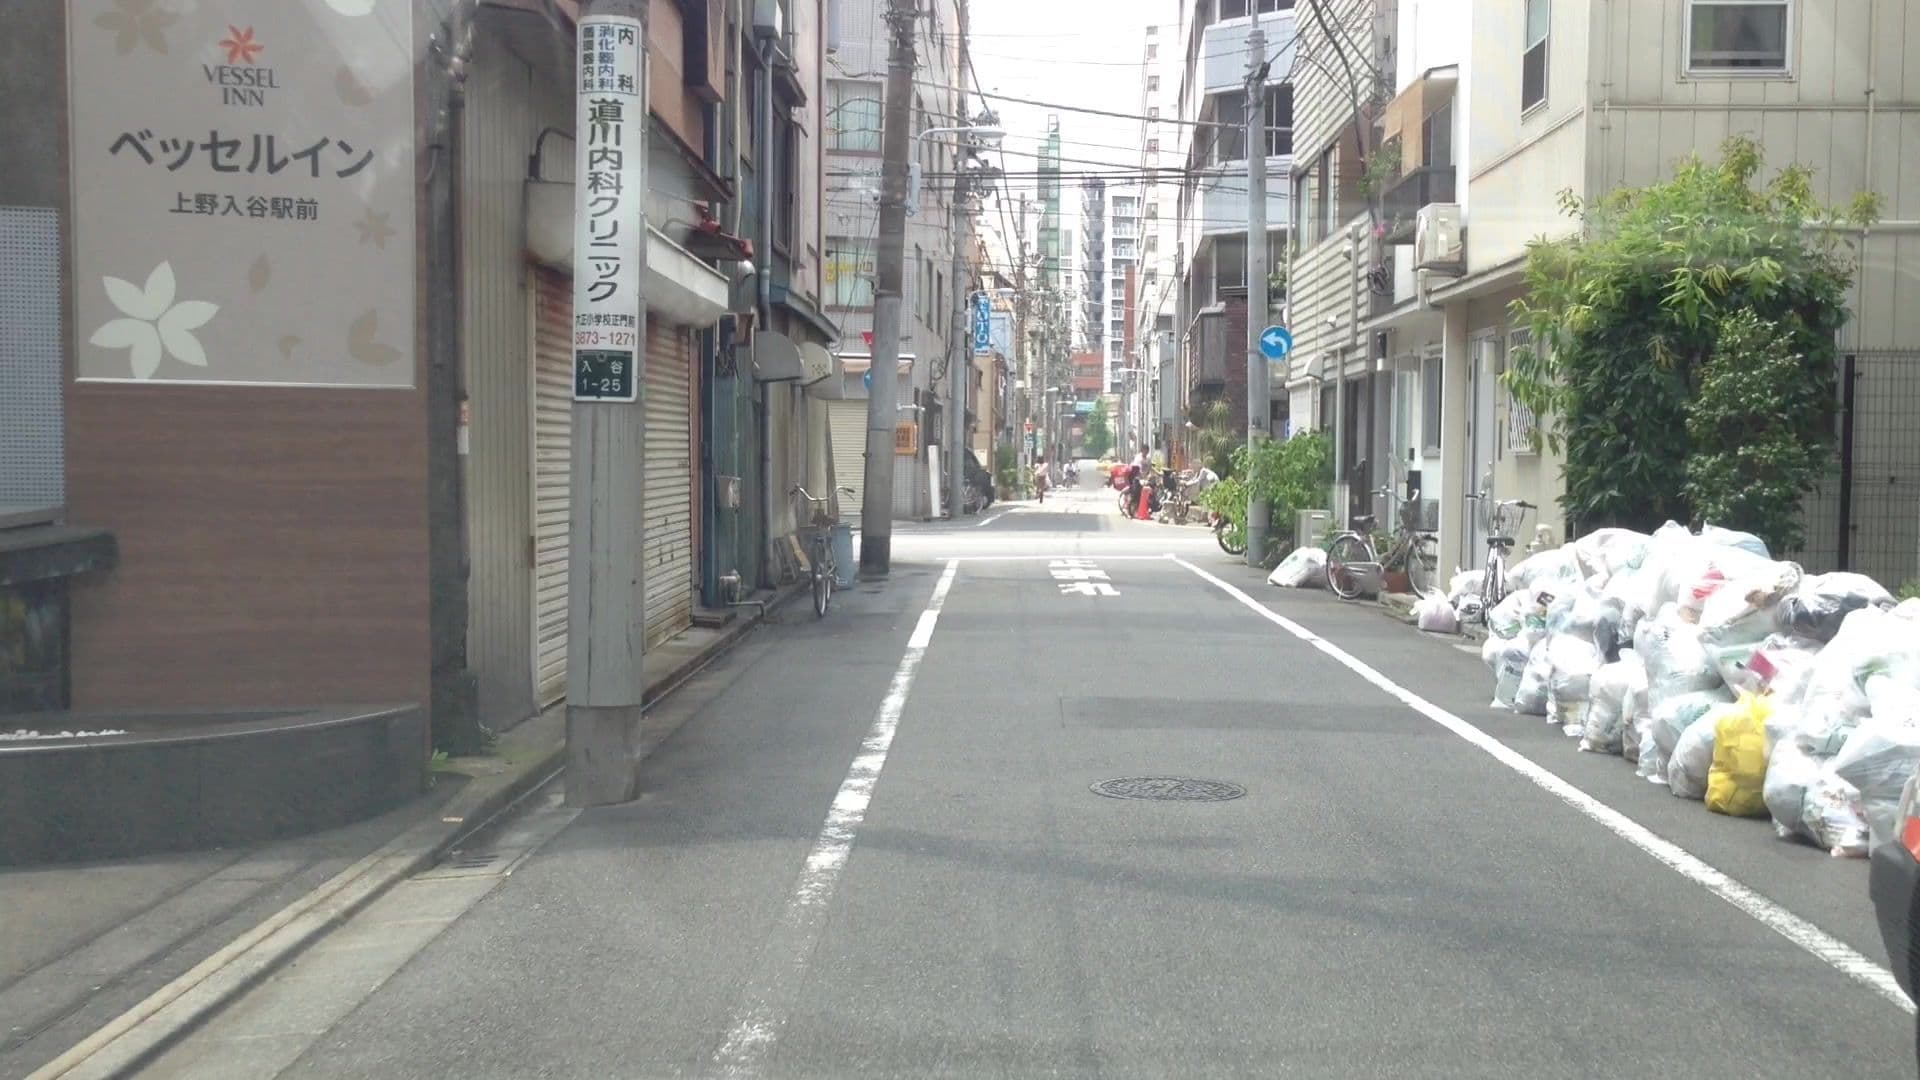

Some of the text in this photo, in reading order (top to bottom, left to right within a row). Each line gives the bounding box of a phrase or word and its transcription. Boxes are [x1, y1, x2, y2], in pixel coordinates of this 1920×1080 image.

[598, 25, 615, 91] 消化器内科
[617, 27, 635, 93] 内科
[202, 63, 280, 89] VESSEL
[222, 87, 265, 107] INN
[109, 128, 375, 179] ベッセルイン
[168, 191, 319, 221] 上野入谷駅前
[587, 98, 625, 303] 道川内科クリニック
[581, 360, 624, 375] 入谷
[582, 378, 622, 393] 1-25
